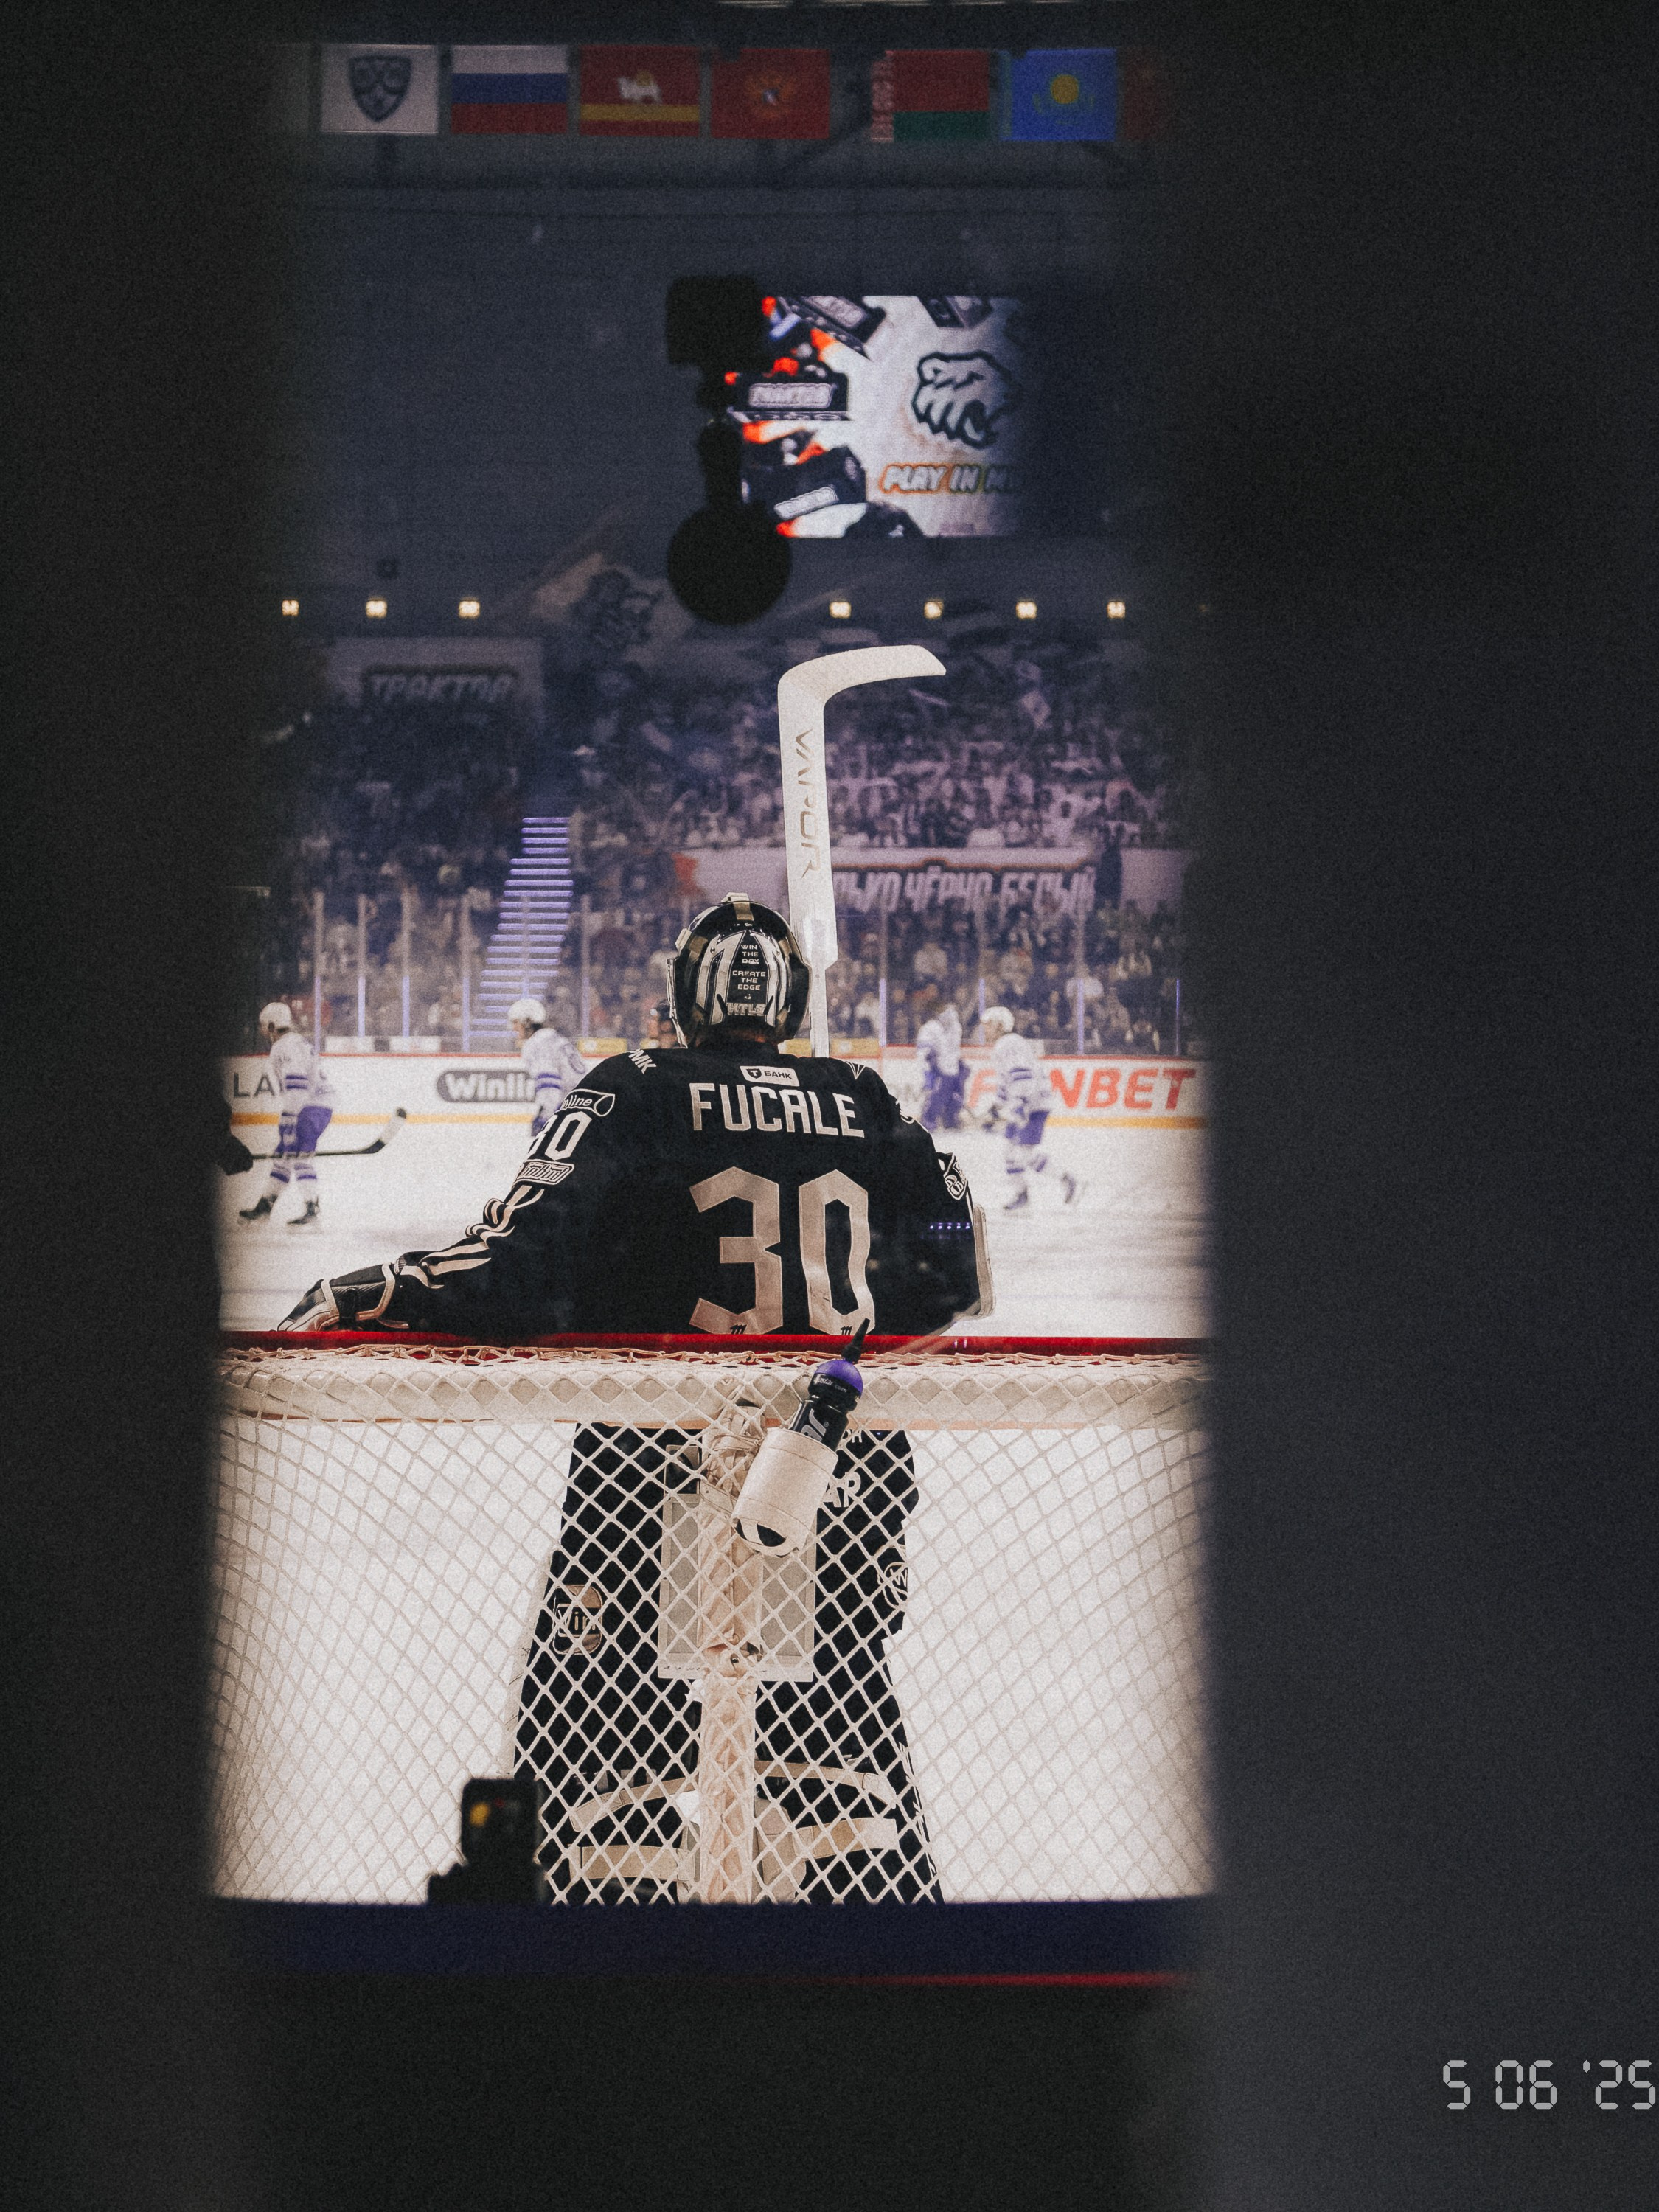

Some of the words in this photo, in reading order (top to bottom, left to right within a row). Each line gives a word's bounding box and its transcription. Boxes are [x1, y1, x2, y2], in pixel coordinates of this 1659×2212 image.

[883, 466, 945, 490] PLAY
[949, 466, 981, 490] IN
[232, 1072, 276, 1099] LA
[445, 1071, 535, 1101] Winli
[765, 1071, 792, 1079] БАНК
[967, 1068, 1196, 1110] FNBET
[689, 1082, 865, 1138] FUCALE
[689, 1166, 876, 1336] 30
